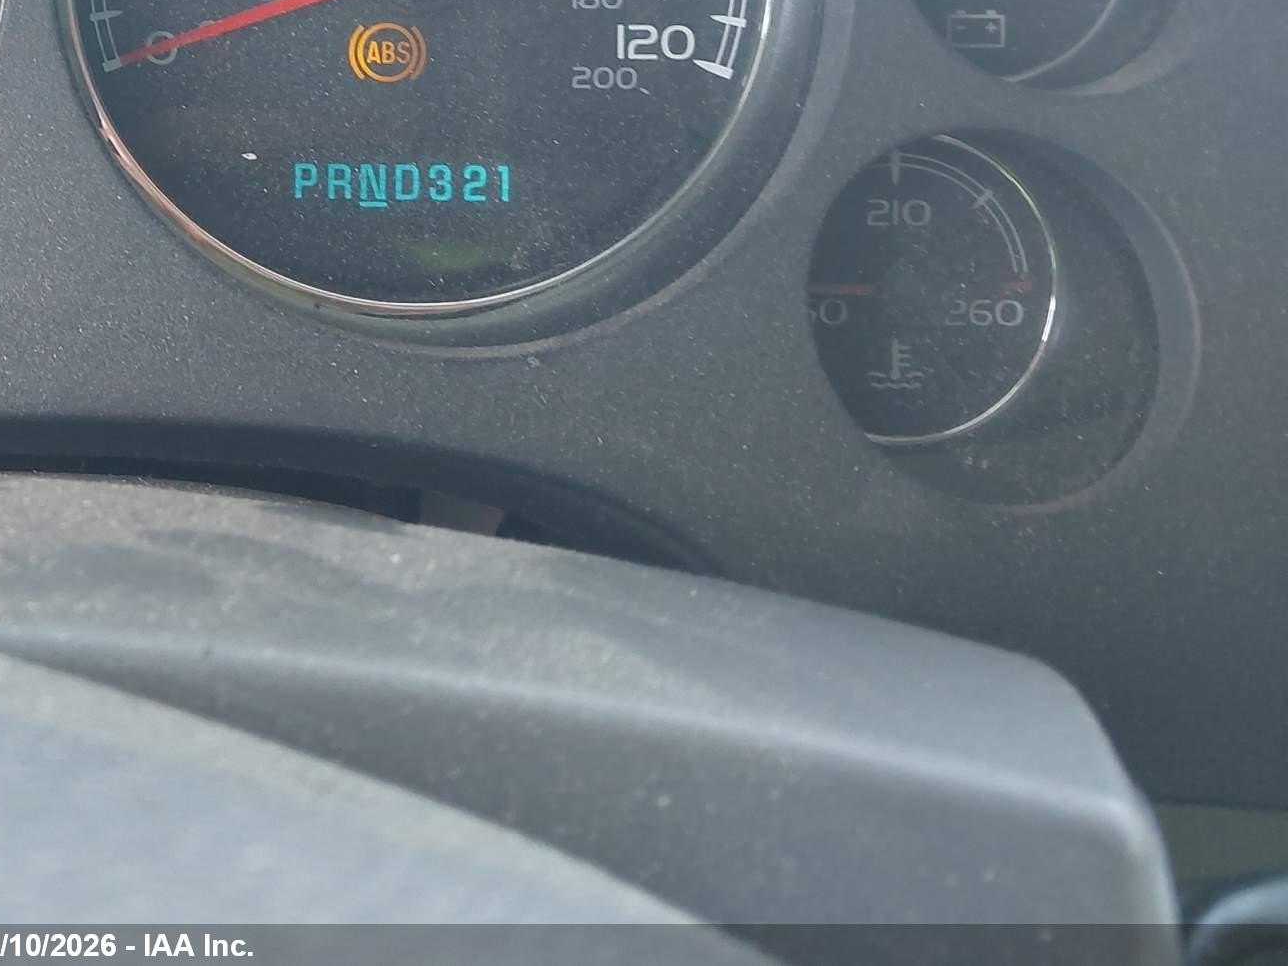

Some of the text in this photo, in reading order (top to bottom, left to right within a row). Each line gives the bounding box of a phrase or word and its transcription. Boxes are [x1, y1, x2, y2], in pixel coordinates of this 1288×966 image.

[366, 40, 410, 65] ABS
[616, 26, 695, 60] 120
[571, 67, 638, 90] 200
[867, 199, 932, 226] 210
[944, 299, 1024, 326] 260
